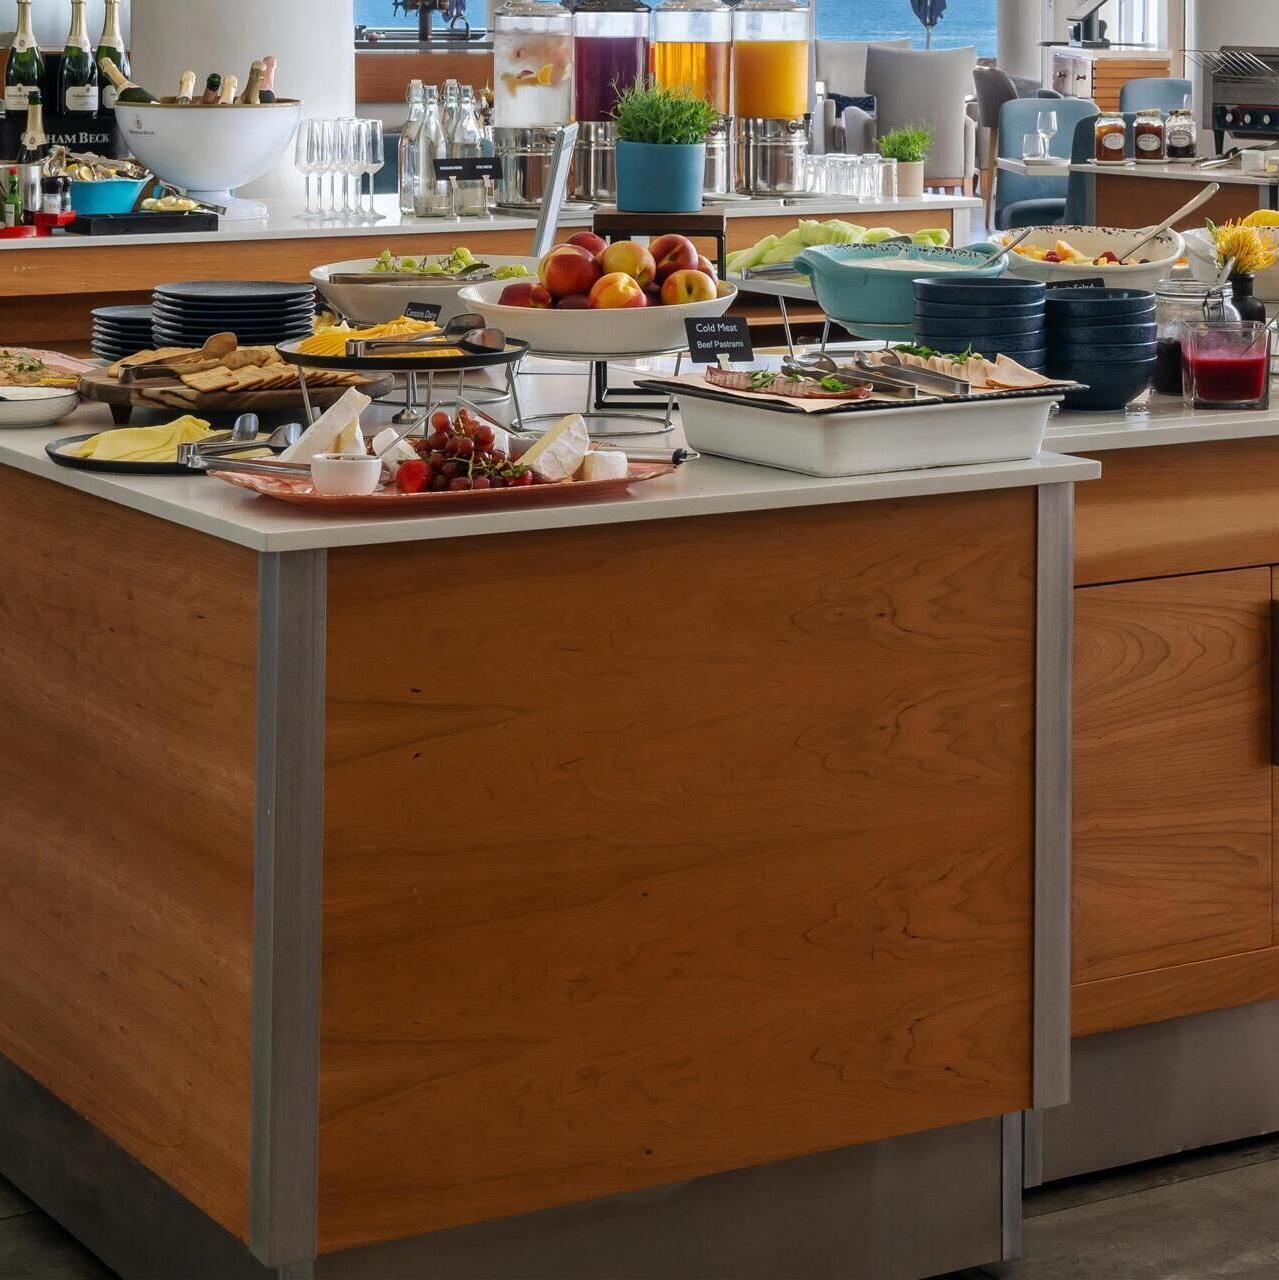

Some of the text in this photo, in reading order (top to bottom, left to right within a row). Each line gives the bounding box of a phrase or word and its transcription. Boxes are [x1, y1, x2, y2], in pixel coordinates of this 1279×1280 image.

[79, 131, 109, 144] BECK
[695, 322, 738, 333] Cold Meat
[696, 339, 744, 349] Beef Pastrami
